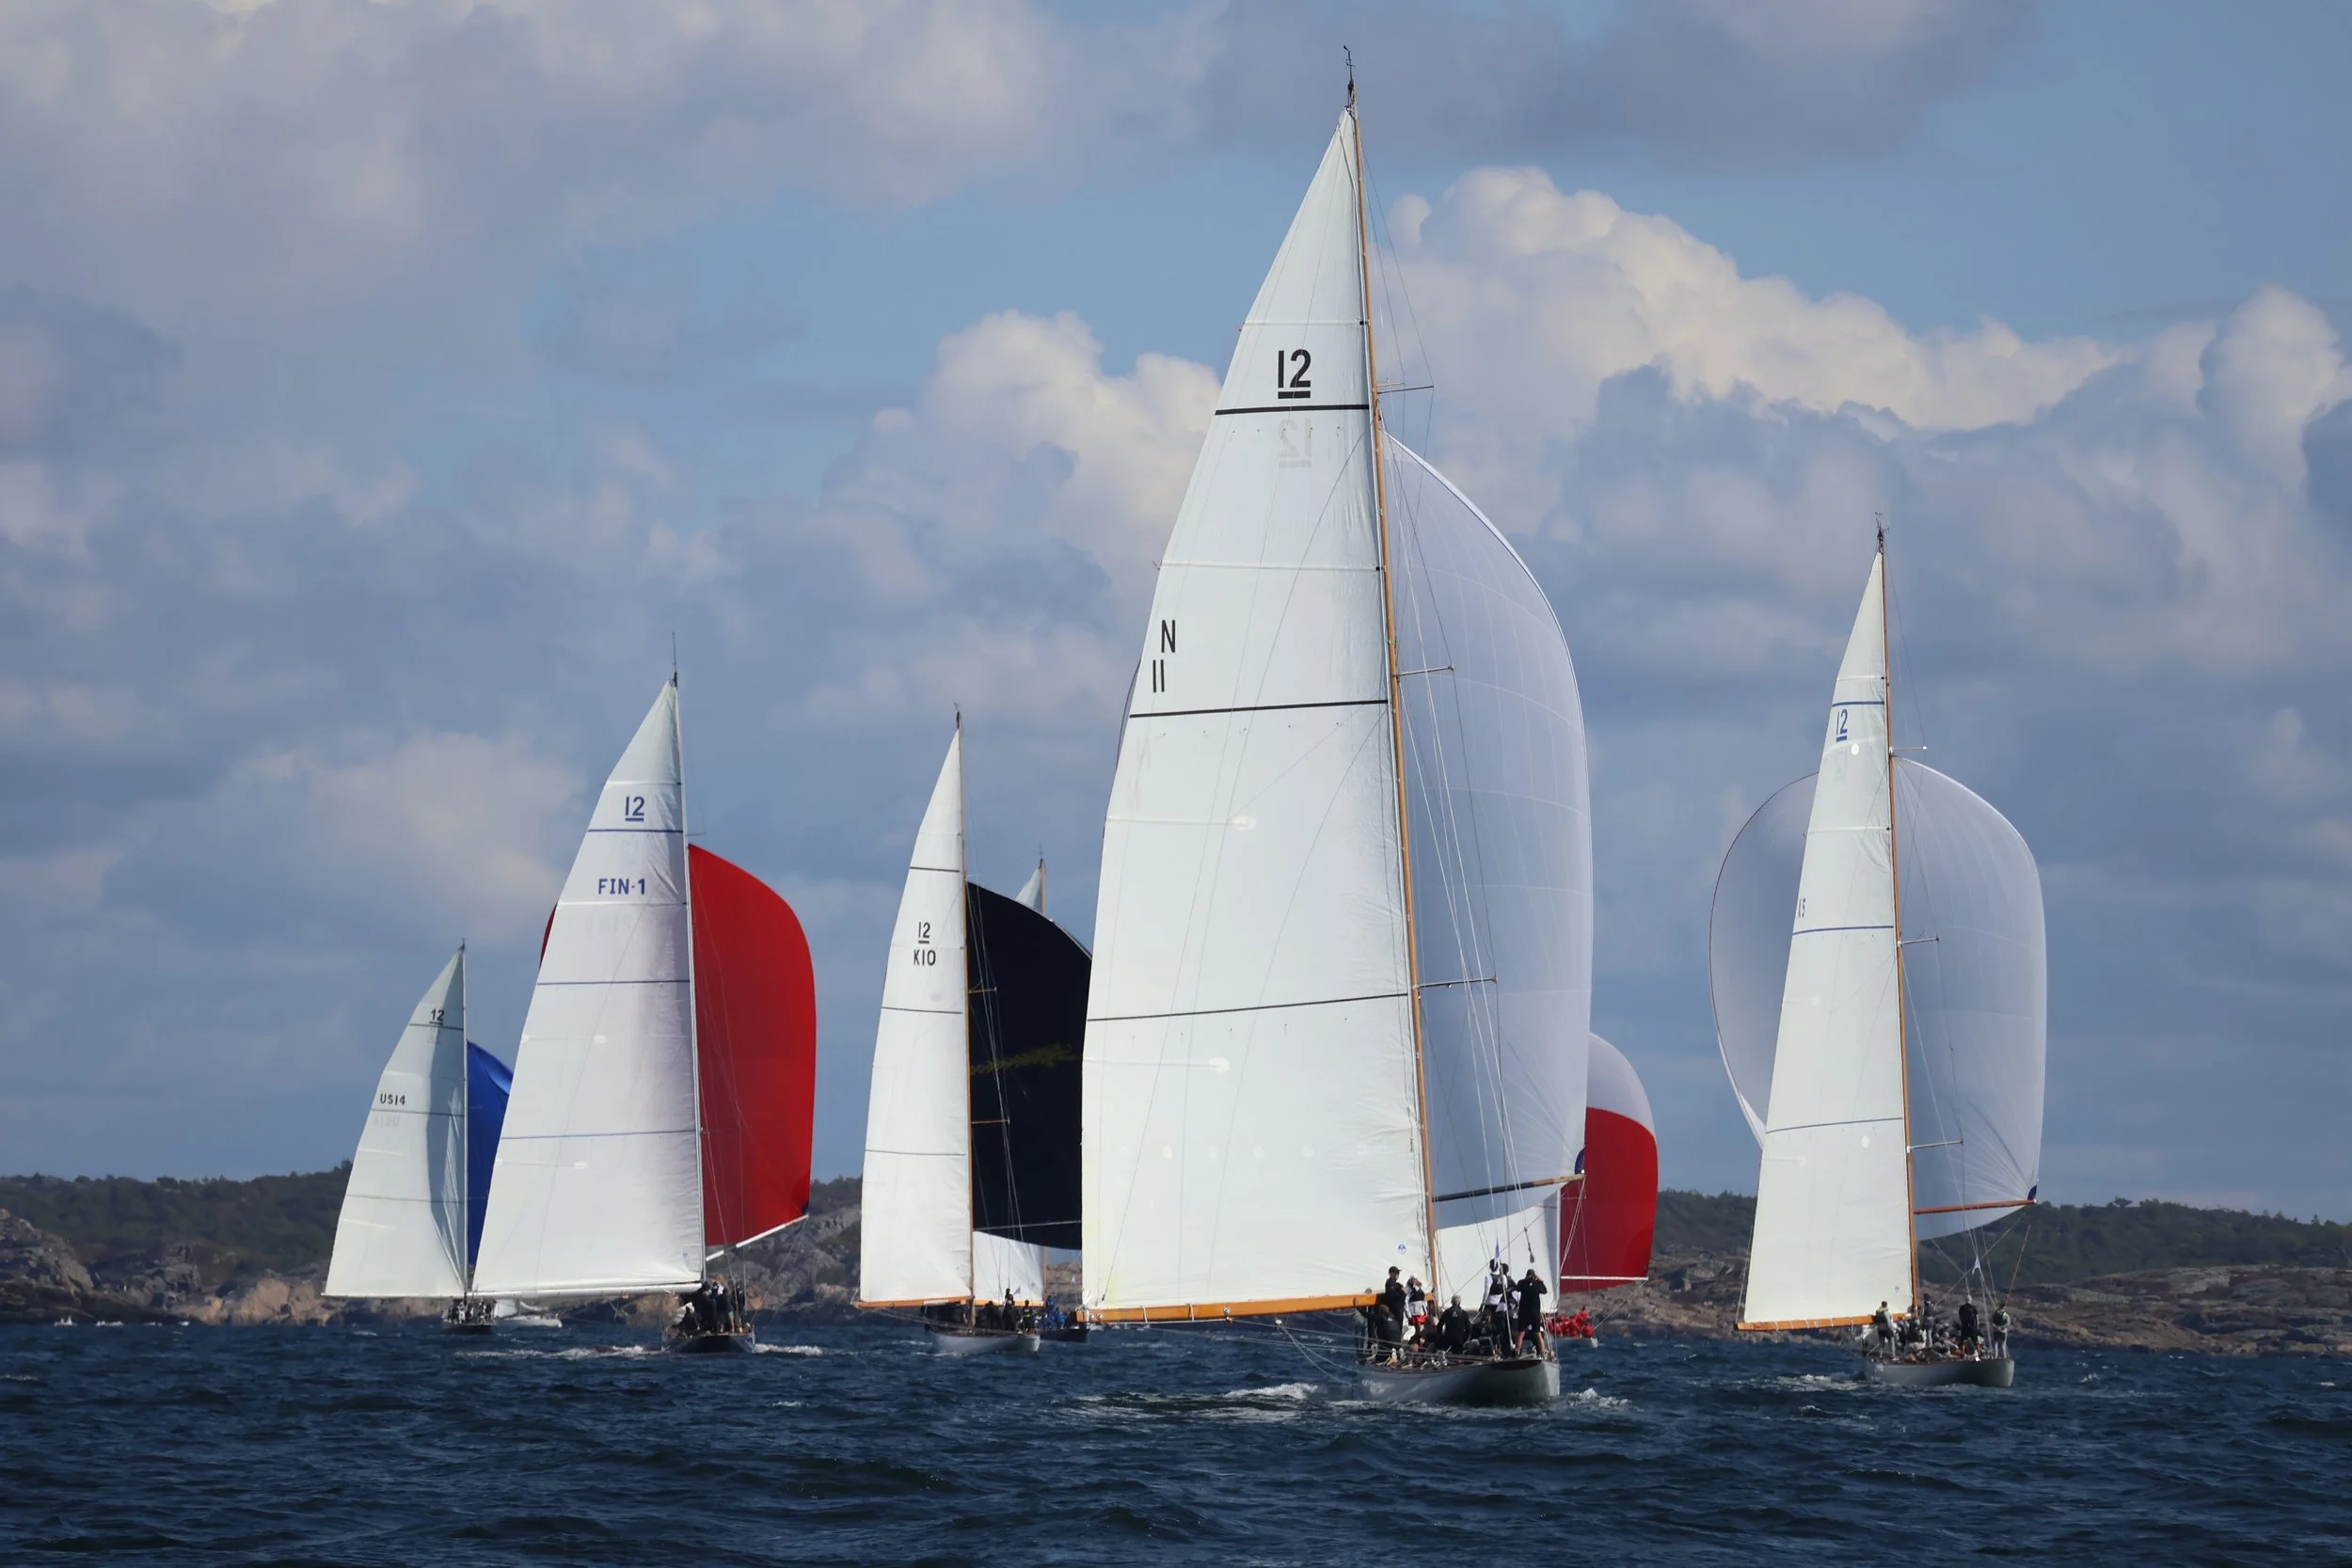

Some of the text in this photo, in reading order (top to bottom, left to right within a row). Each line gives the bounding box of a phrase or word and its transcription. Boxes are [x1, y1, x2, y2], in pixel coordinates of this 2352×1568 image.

[1278, 349, 1311, 388] 12
[1161, 619, 1176, 653] N
[1152, 659, 1165, 692] 11
[1836, 708, 1848, 735] 12
[625, 796, 645, 816] 12
[918, 922, 930, 939] 12
[914, 949, 936, 966] K10
[430, 1008, 445, 1022] 12
[379, 1093, 405, 1106] US14
